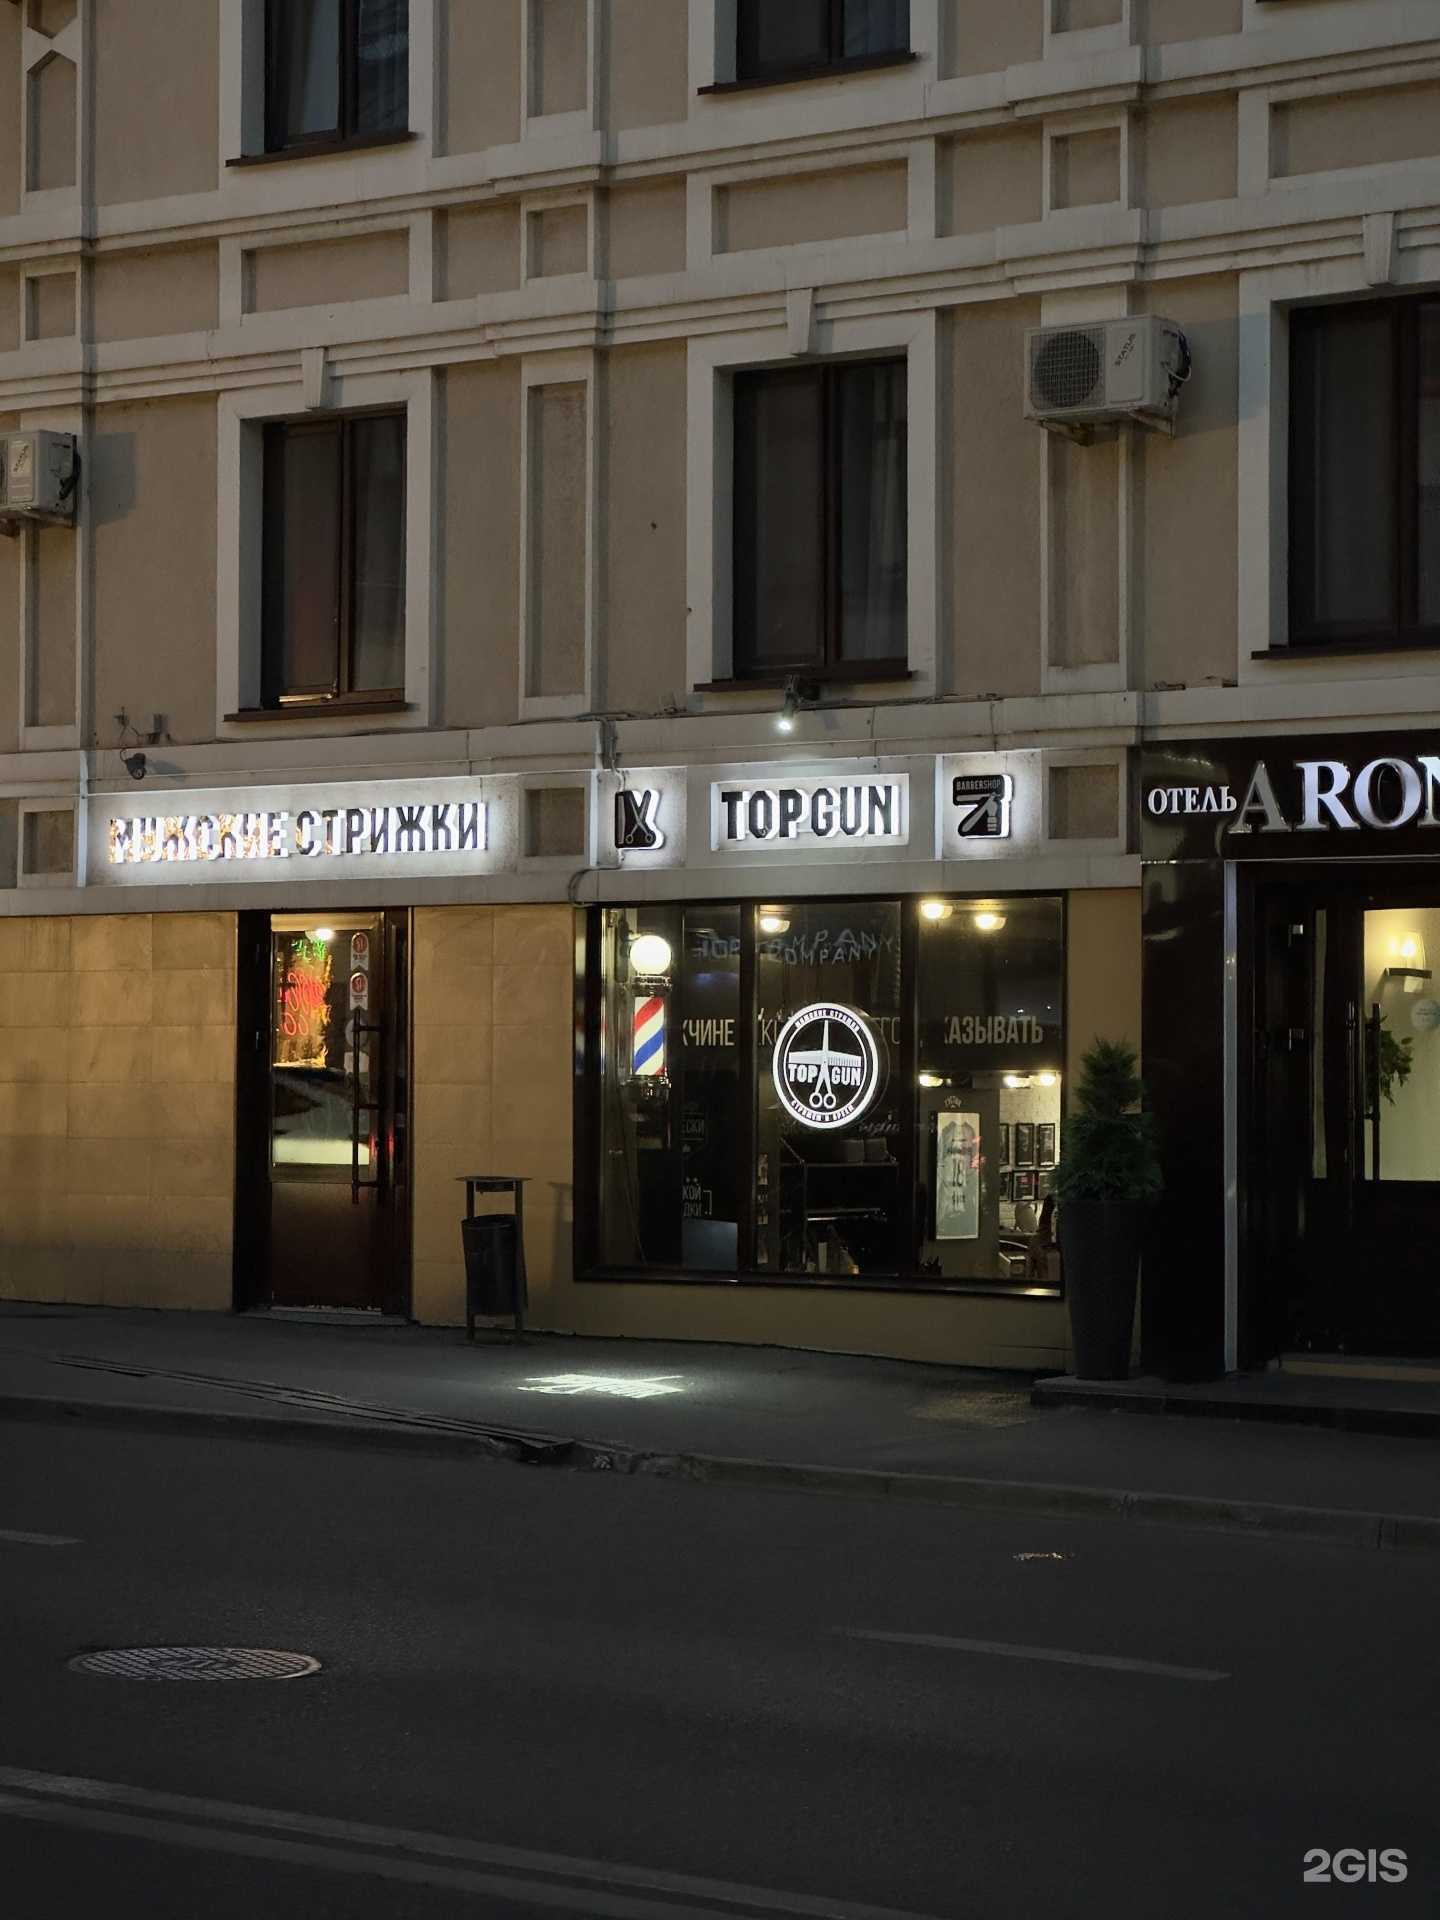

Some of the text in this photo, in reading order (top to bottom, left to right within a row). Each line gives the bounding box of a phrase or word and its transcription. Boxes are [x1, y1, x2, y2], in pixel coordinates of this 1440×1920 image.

[956, 779, 1001, 792] BARBERSHOP
[721, 785, 899, 840] TOPGUN
[1148, 786, 1238, 815] ОТЕЛЬ
[296, 802, 488, 858] СТРИЖКИ
[788, 1064, 861, 1086] TOP GUN
